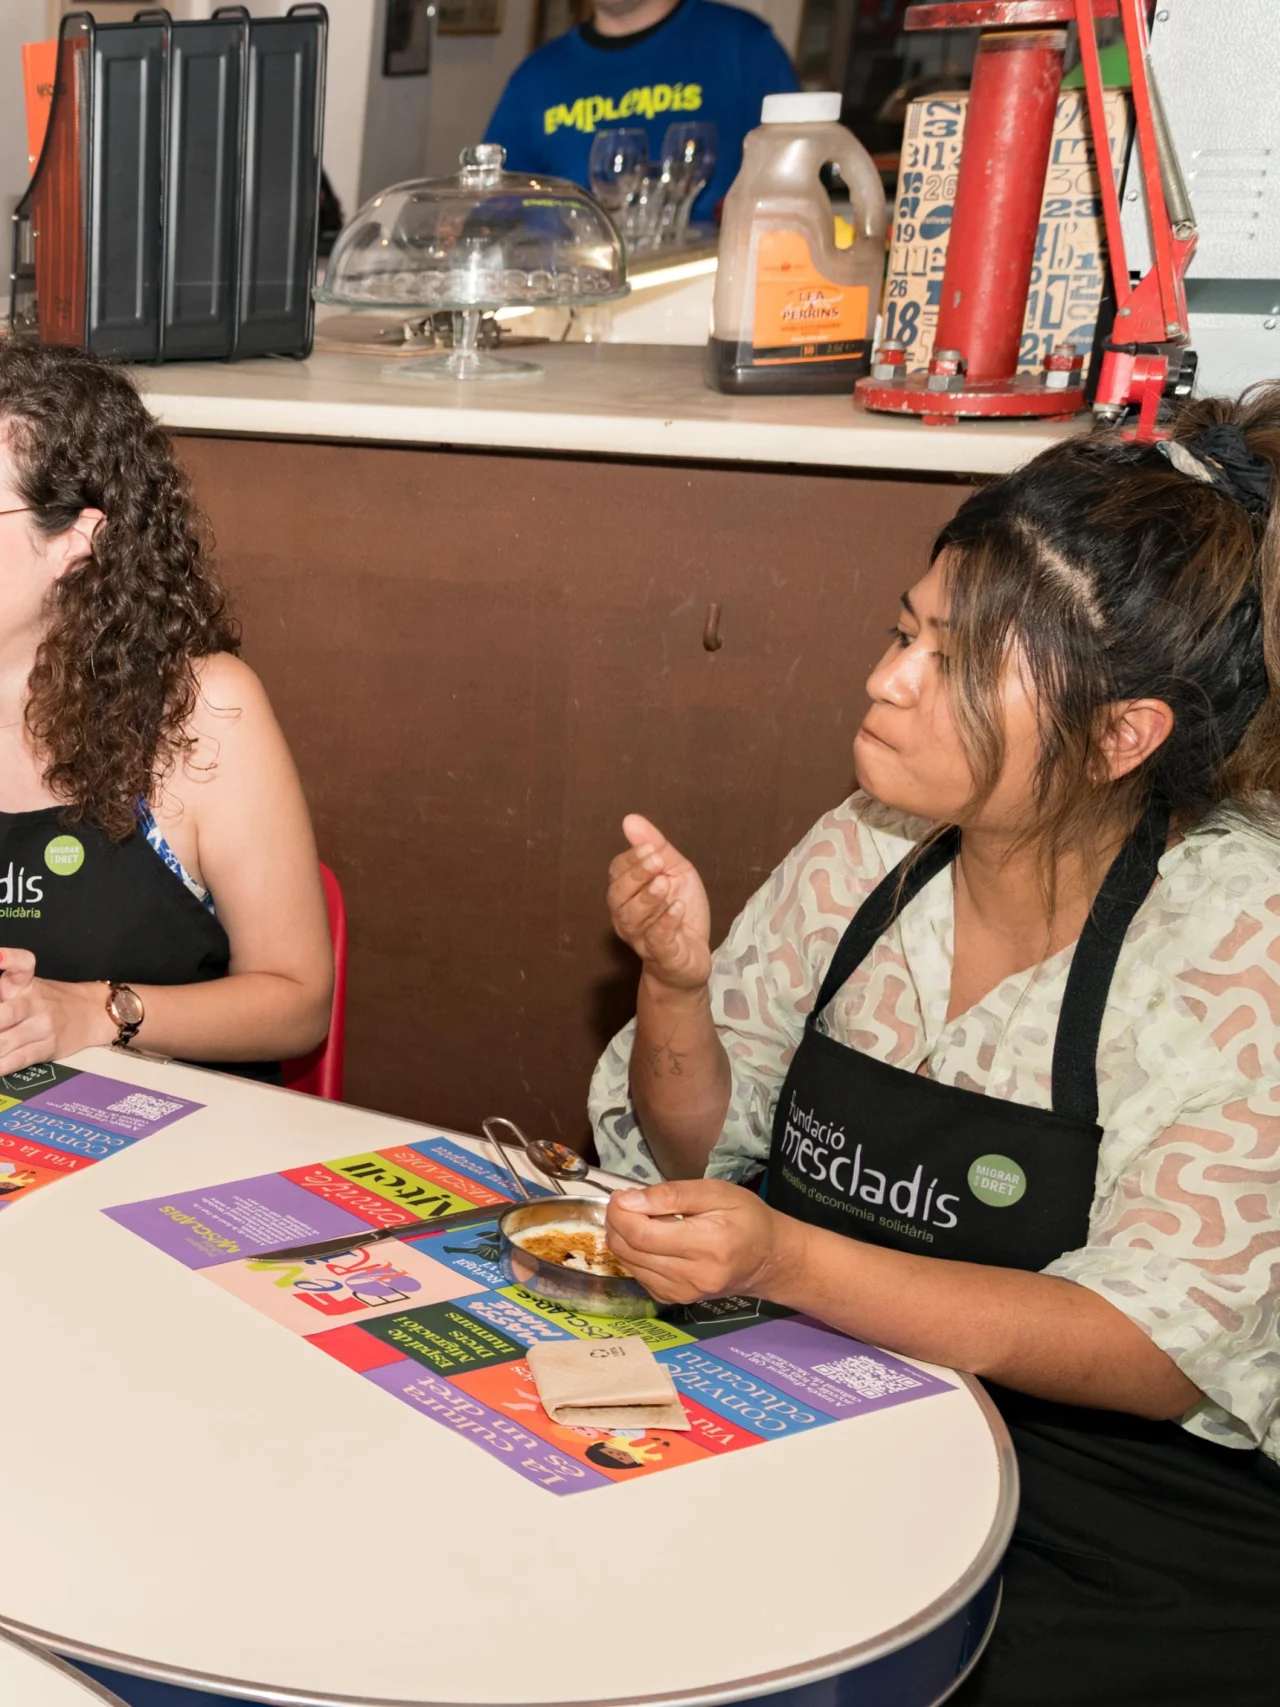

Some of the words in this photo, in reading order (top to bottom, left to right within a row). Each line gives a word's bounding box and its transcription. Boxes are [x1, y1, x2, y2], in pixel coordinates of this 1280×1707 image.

[896, 224, 915, 242] 19
[800, 291, 824, 302] LEA
[889, 280, 907, 298] 26
[783, 308, 838, 320] PERRINS
[887, 301, 921, 347] 18
[55, 855, 79, 864] DRET
[12, 1109, 124, 1146] educatiu
[789, 1089, 845, 1150] fundació
[20, 1145, 41, 1157] la
[45, 1153, 77, 1169] Viu
[781, 1120, 960, 1229] mescladís
[975, 1164, 1020, 1185] MIGRAR
[980, 1177, 1017, 1196] DRET
[808, 1186, 875, 1222] d'economia
[878, 1215, 934, 1244] solidària
[444, 1311, 517, 1354] Humans
[488, 1300, 564, 1338] MARE
[388, 1328, 413, 1343] de
[404, 1319, 475, 1364] Migració
[448, 1330, 497, 1359] Drets
[405, 1337, 456, 1369] Espai
[417, 1375, 485, 1416] dret
[675, 1351, 816, 1424] educatiu
[402, 1384, 515, 1452] cultura
[692, 1417, 736, 1445] Viu
[490, 1420, 539, 1449] un
[521, 1458, 567, 1485] La
[544, 1454, 585, 1478] és
